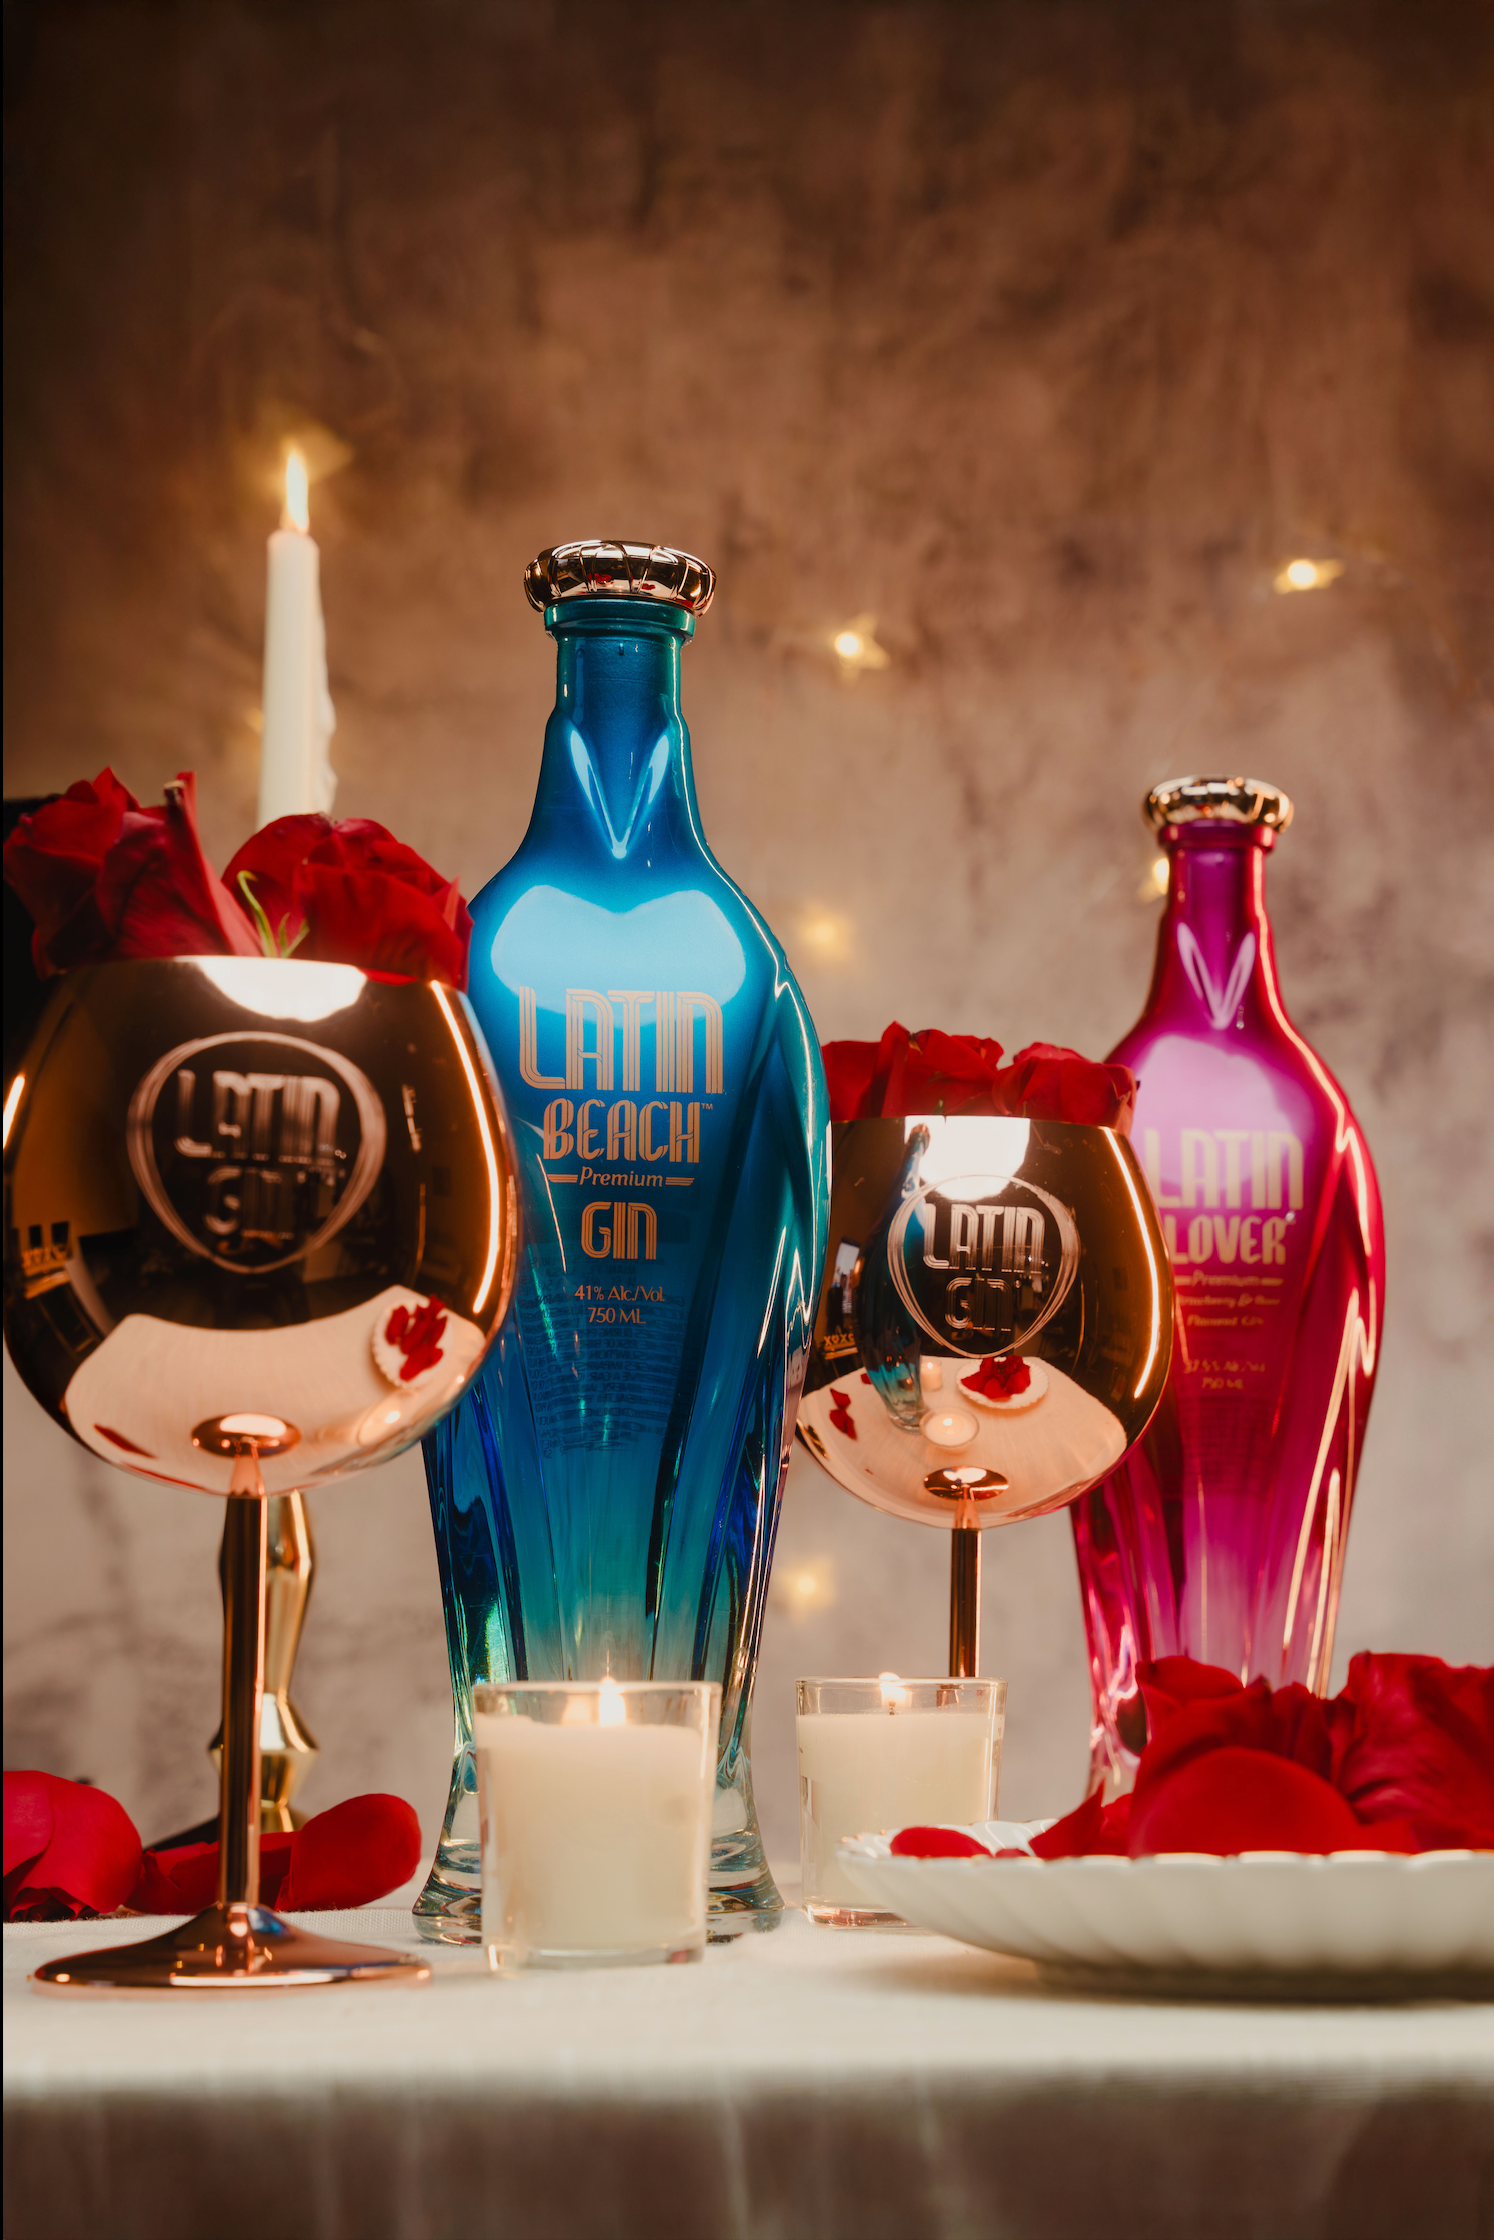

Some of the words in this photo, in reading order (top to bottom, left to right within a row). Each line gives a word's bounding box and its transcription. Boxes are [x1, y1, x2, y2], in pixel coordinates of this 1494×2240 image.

[518, 985, 723, 1094] LATIN
[175, 1069, 341, 1166] LATIN
[579, 1165, 664, 1188] Premium
[1144, 1127, 1304, 1210] LATIN
[580, 1201, 658, 1260] GIN
[922, 1202, 1045, 1274] LATIN
[1163, 1214, 1287, 1265] LOVER
[574, 1284, 605, 1301] 41%
[587, 1307, 616, 1324] 750
[619, 1308, 647, 1325] ML
